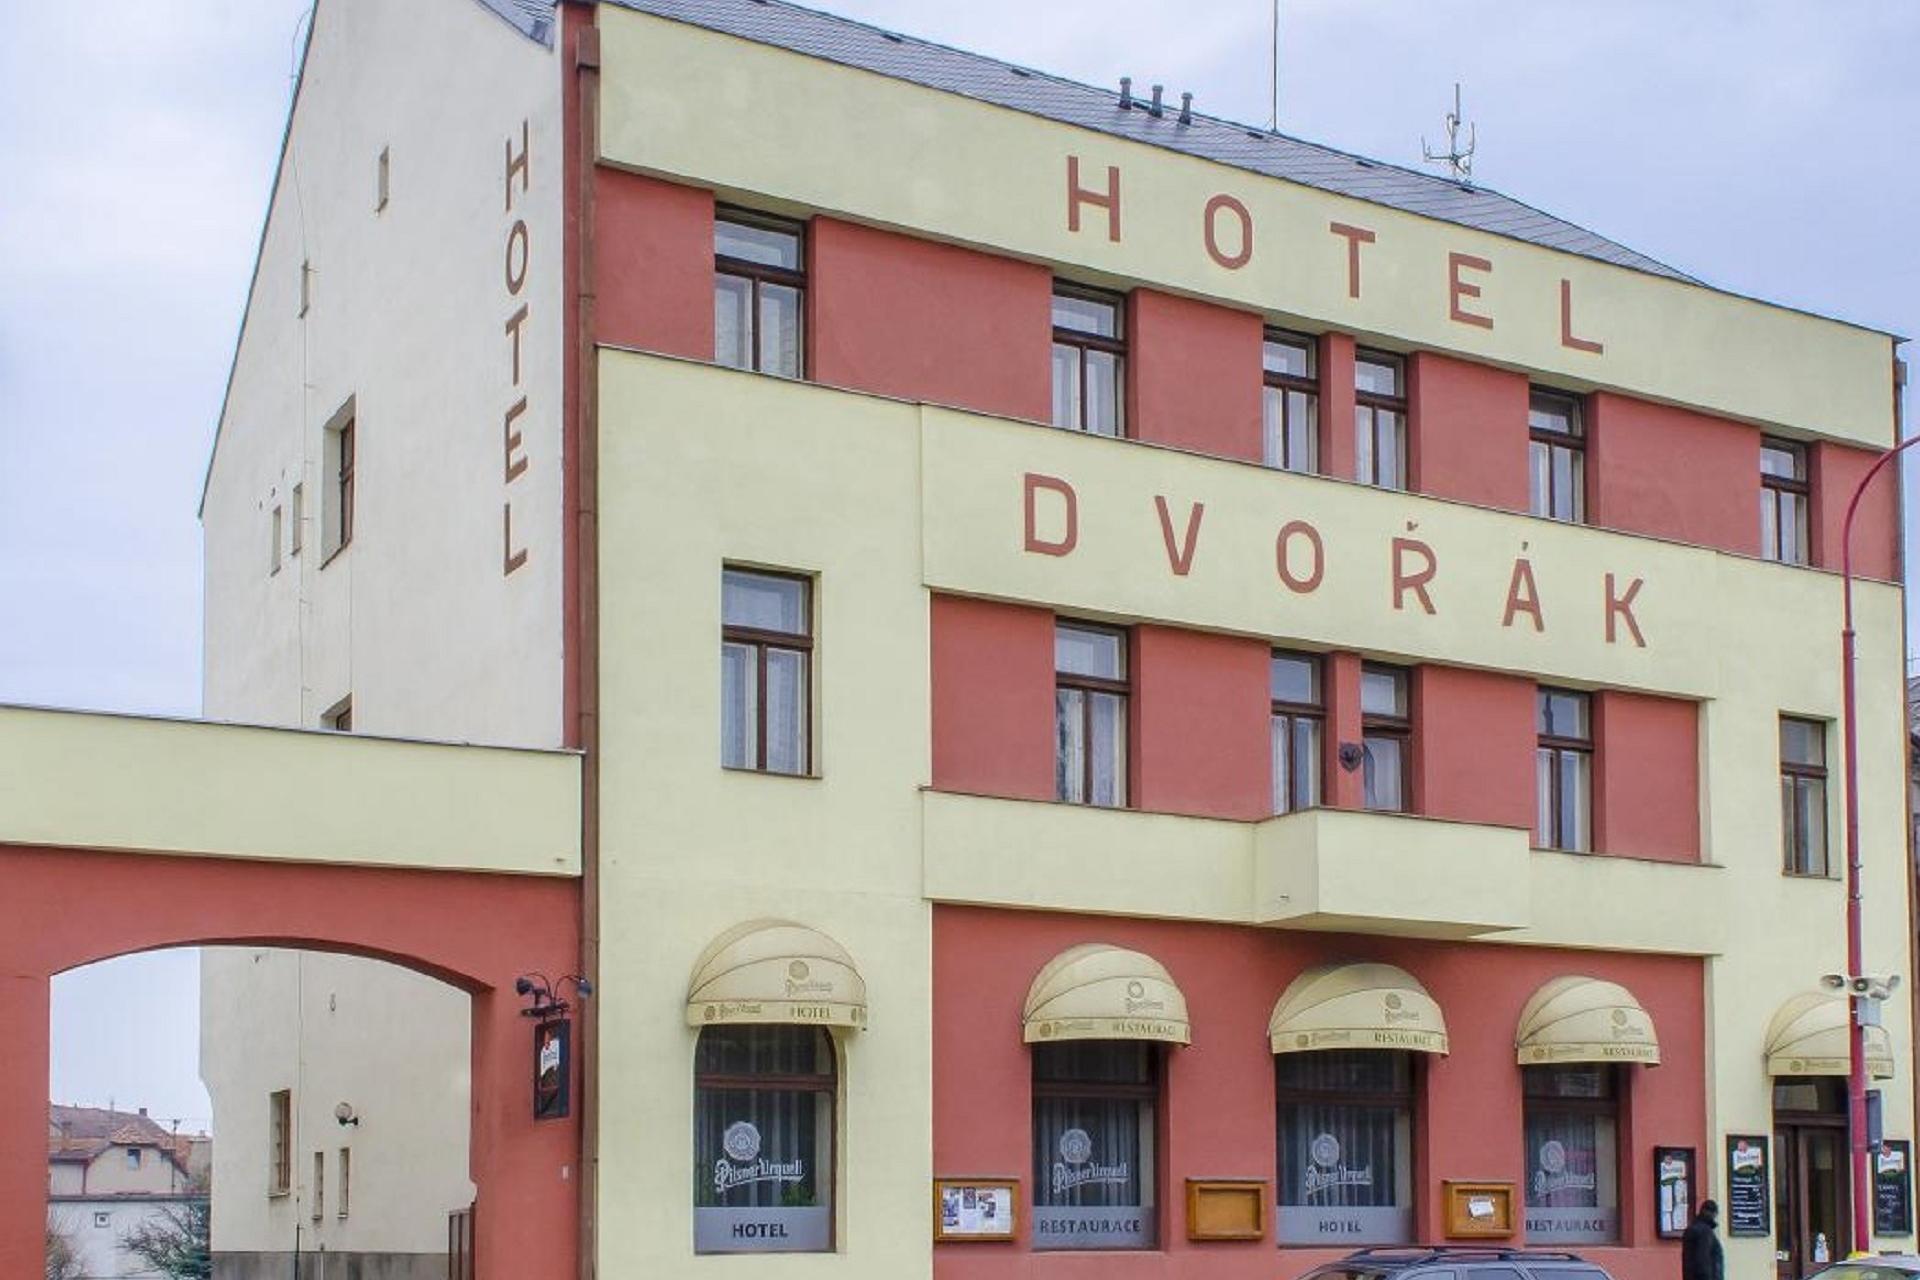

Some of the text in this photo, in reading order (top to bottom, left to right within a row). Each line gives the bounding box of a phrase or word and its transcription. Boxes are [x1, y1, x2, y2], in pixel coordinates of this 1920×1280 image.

[1066, 155, 1604, 355] HOTEL
[503, 116, 529, 577] HOTEL
[1023, 471, 1647, 648] DVOŘÁK
[790, 1006, 831, 1019] HOTEL
[714, 1157, 803, 1193] Pilsner Urquell
[732, 1223, 788, 1238] HOTEL
[1040, 1219, 1141, 1233] RESTAURACE
[1319, 1220, 1362, 1232] HOTEL
